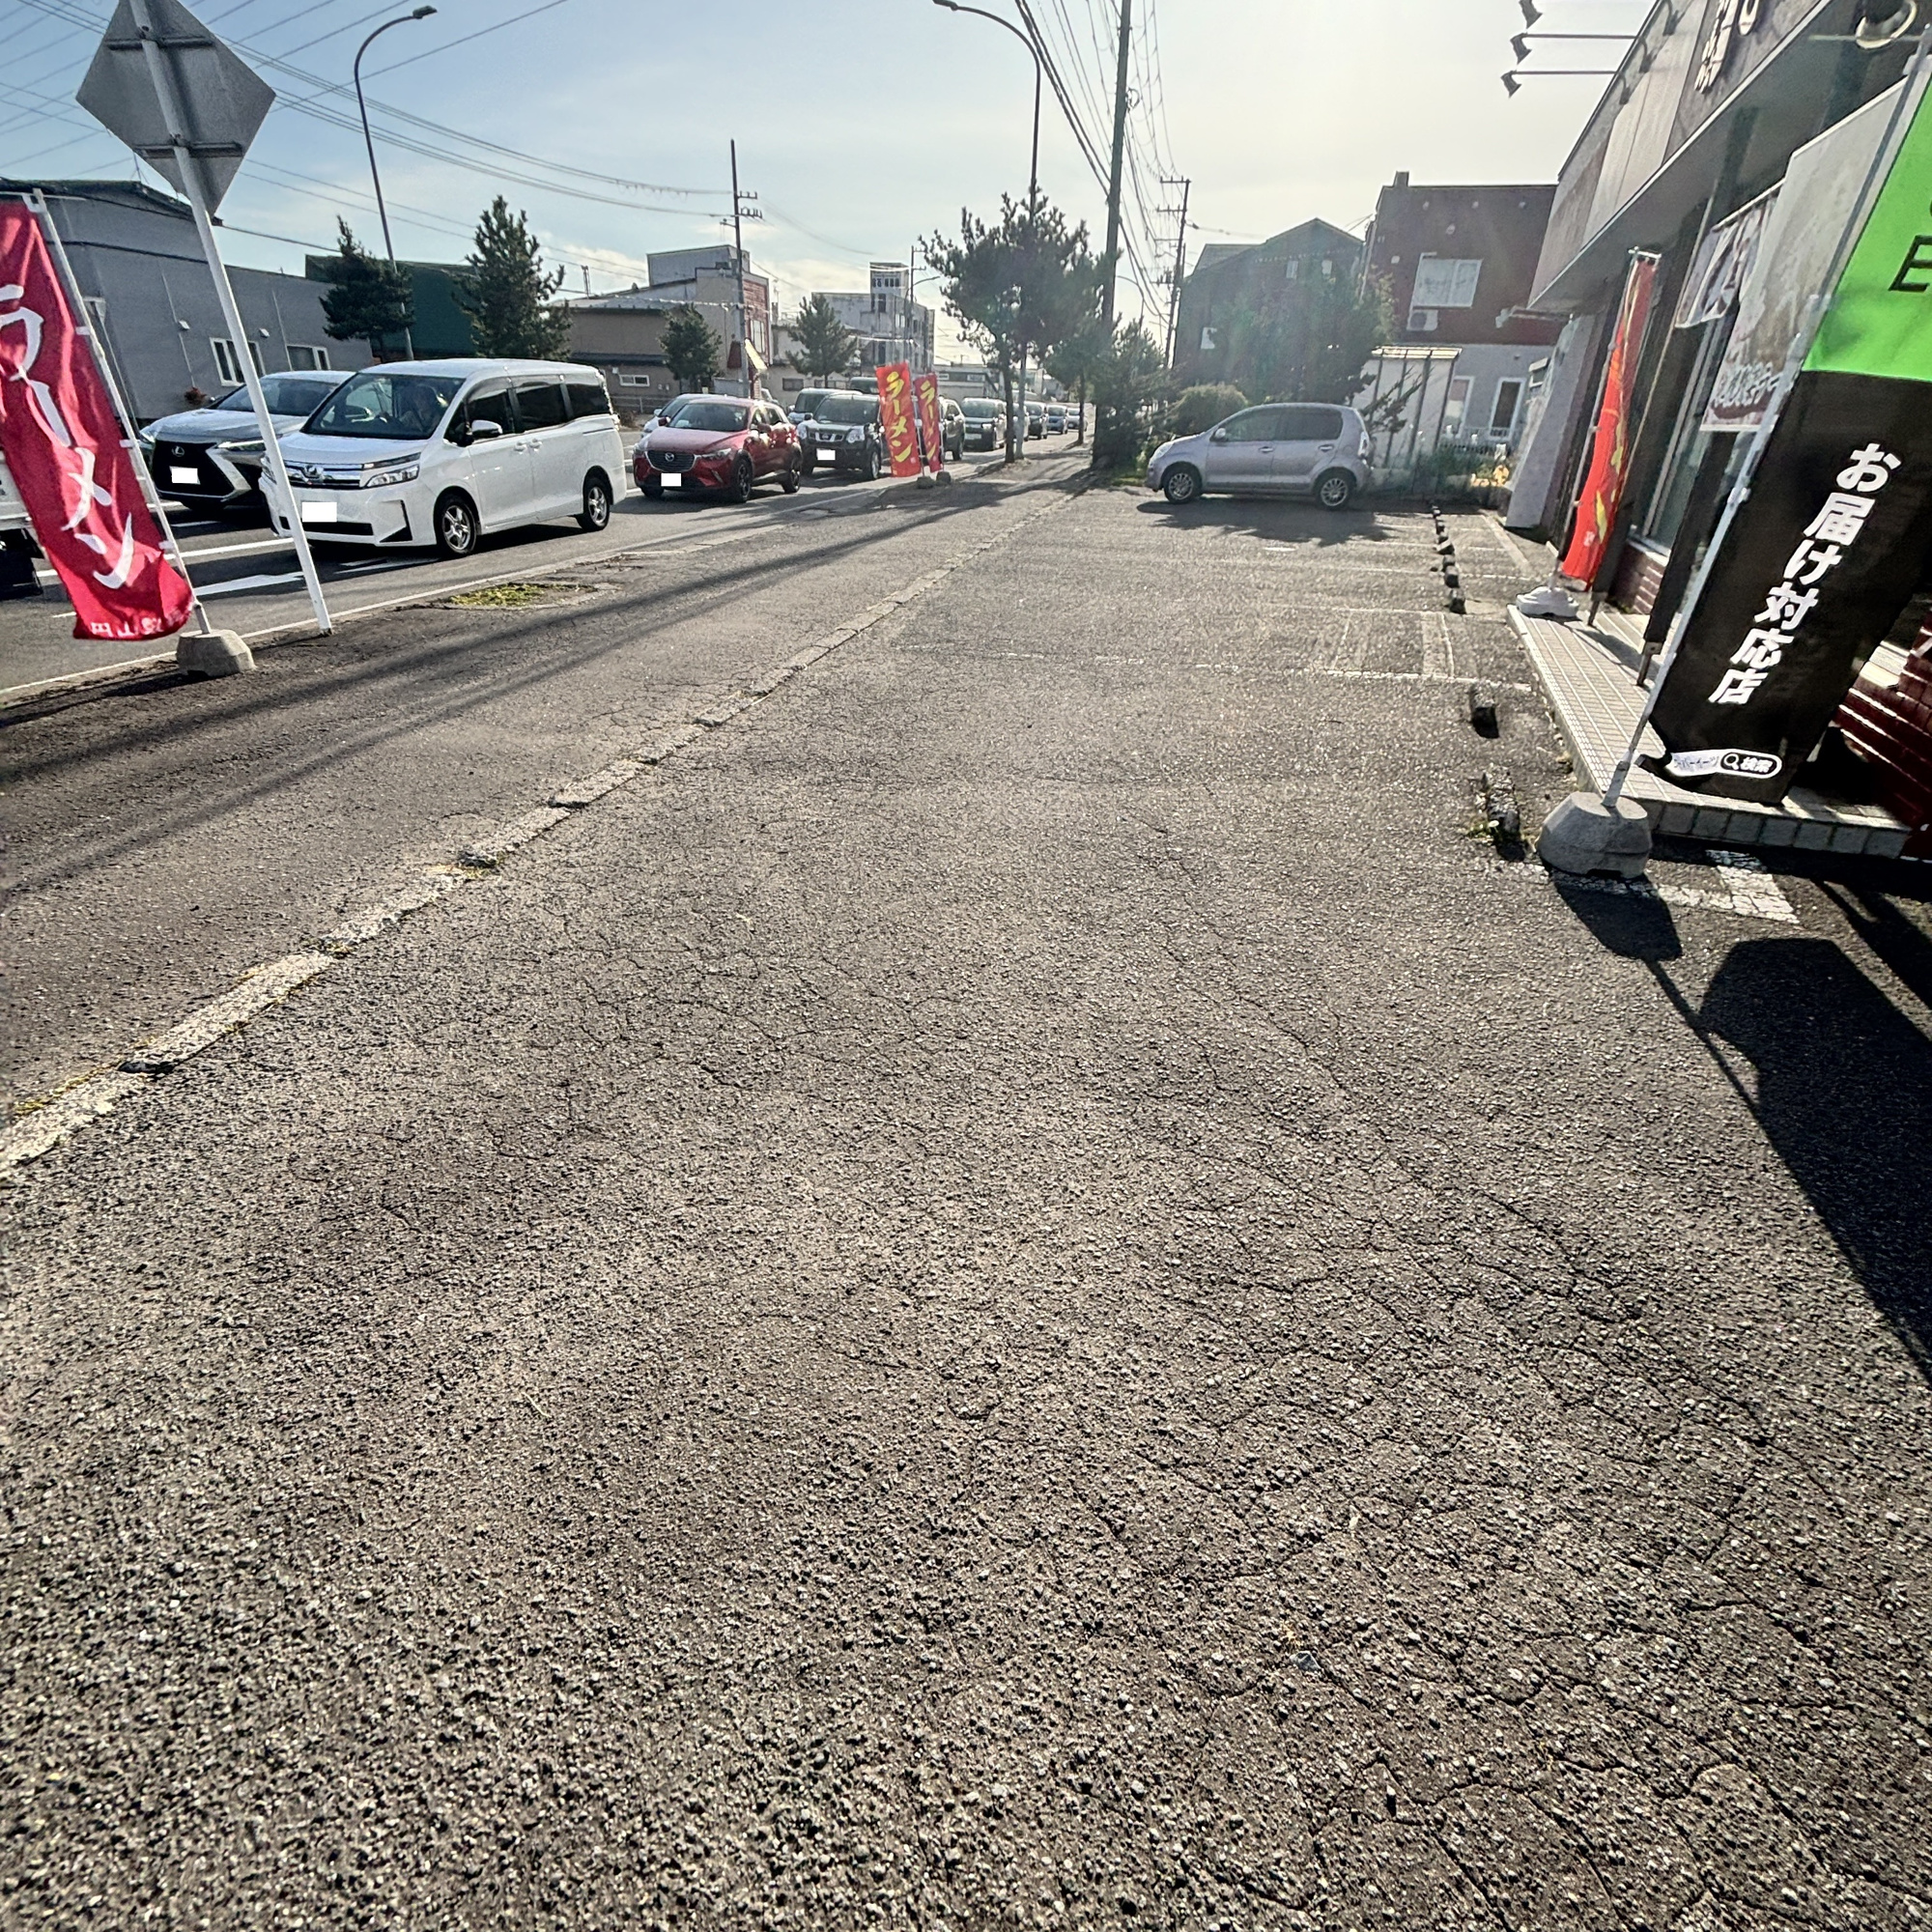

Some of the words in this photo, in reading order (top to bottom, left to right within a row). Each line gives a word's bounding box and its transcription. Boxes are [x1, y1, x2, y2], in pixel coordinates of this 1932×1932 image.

[0, 283, 134, 589] ラーメン
[886, 371, 913, 463] ラーメン
[921, 380, 936, 460] ラーメン
[1708, 442, 1901, 704] お届け対応店
